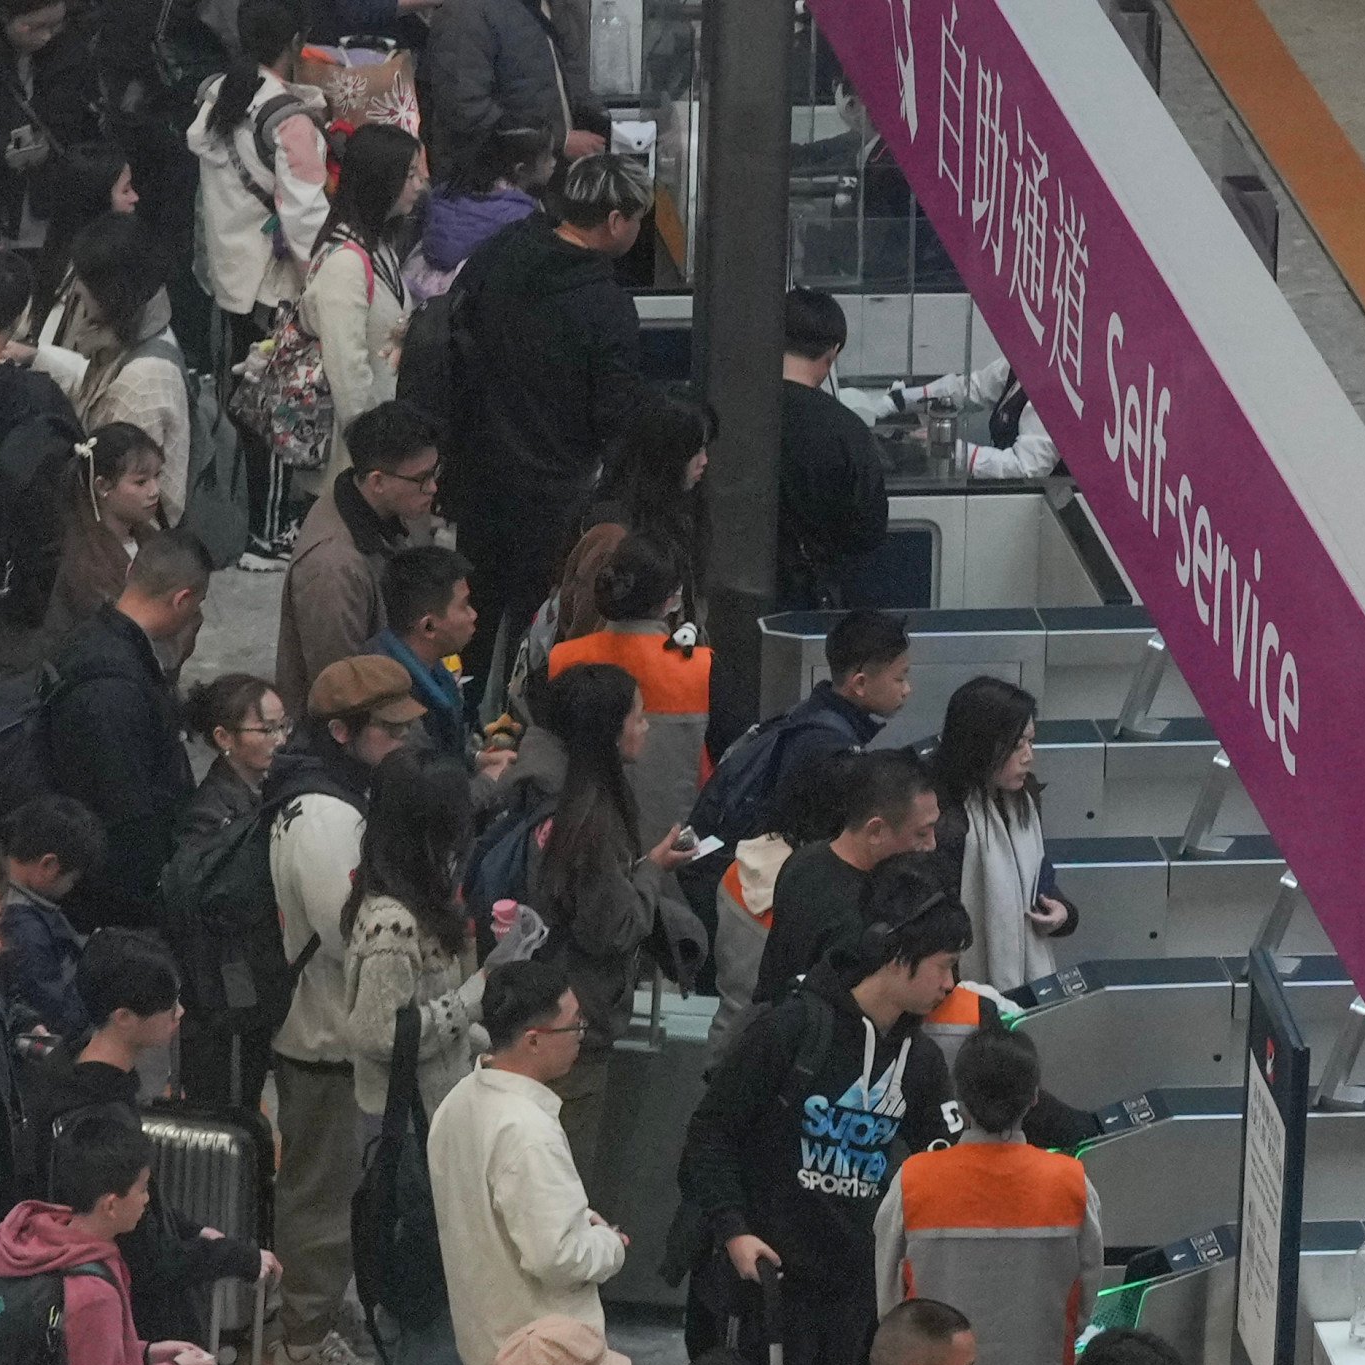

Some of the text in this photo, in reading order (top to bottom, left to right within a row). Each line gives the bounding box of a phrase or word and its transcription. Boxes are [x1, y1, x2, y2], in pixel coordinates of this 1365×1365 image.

[937, 8, 1089, 418] 自助通道
[1104, 311, 1300, 777] Self-service
